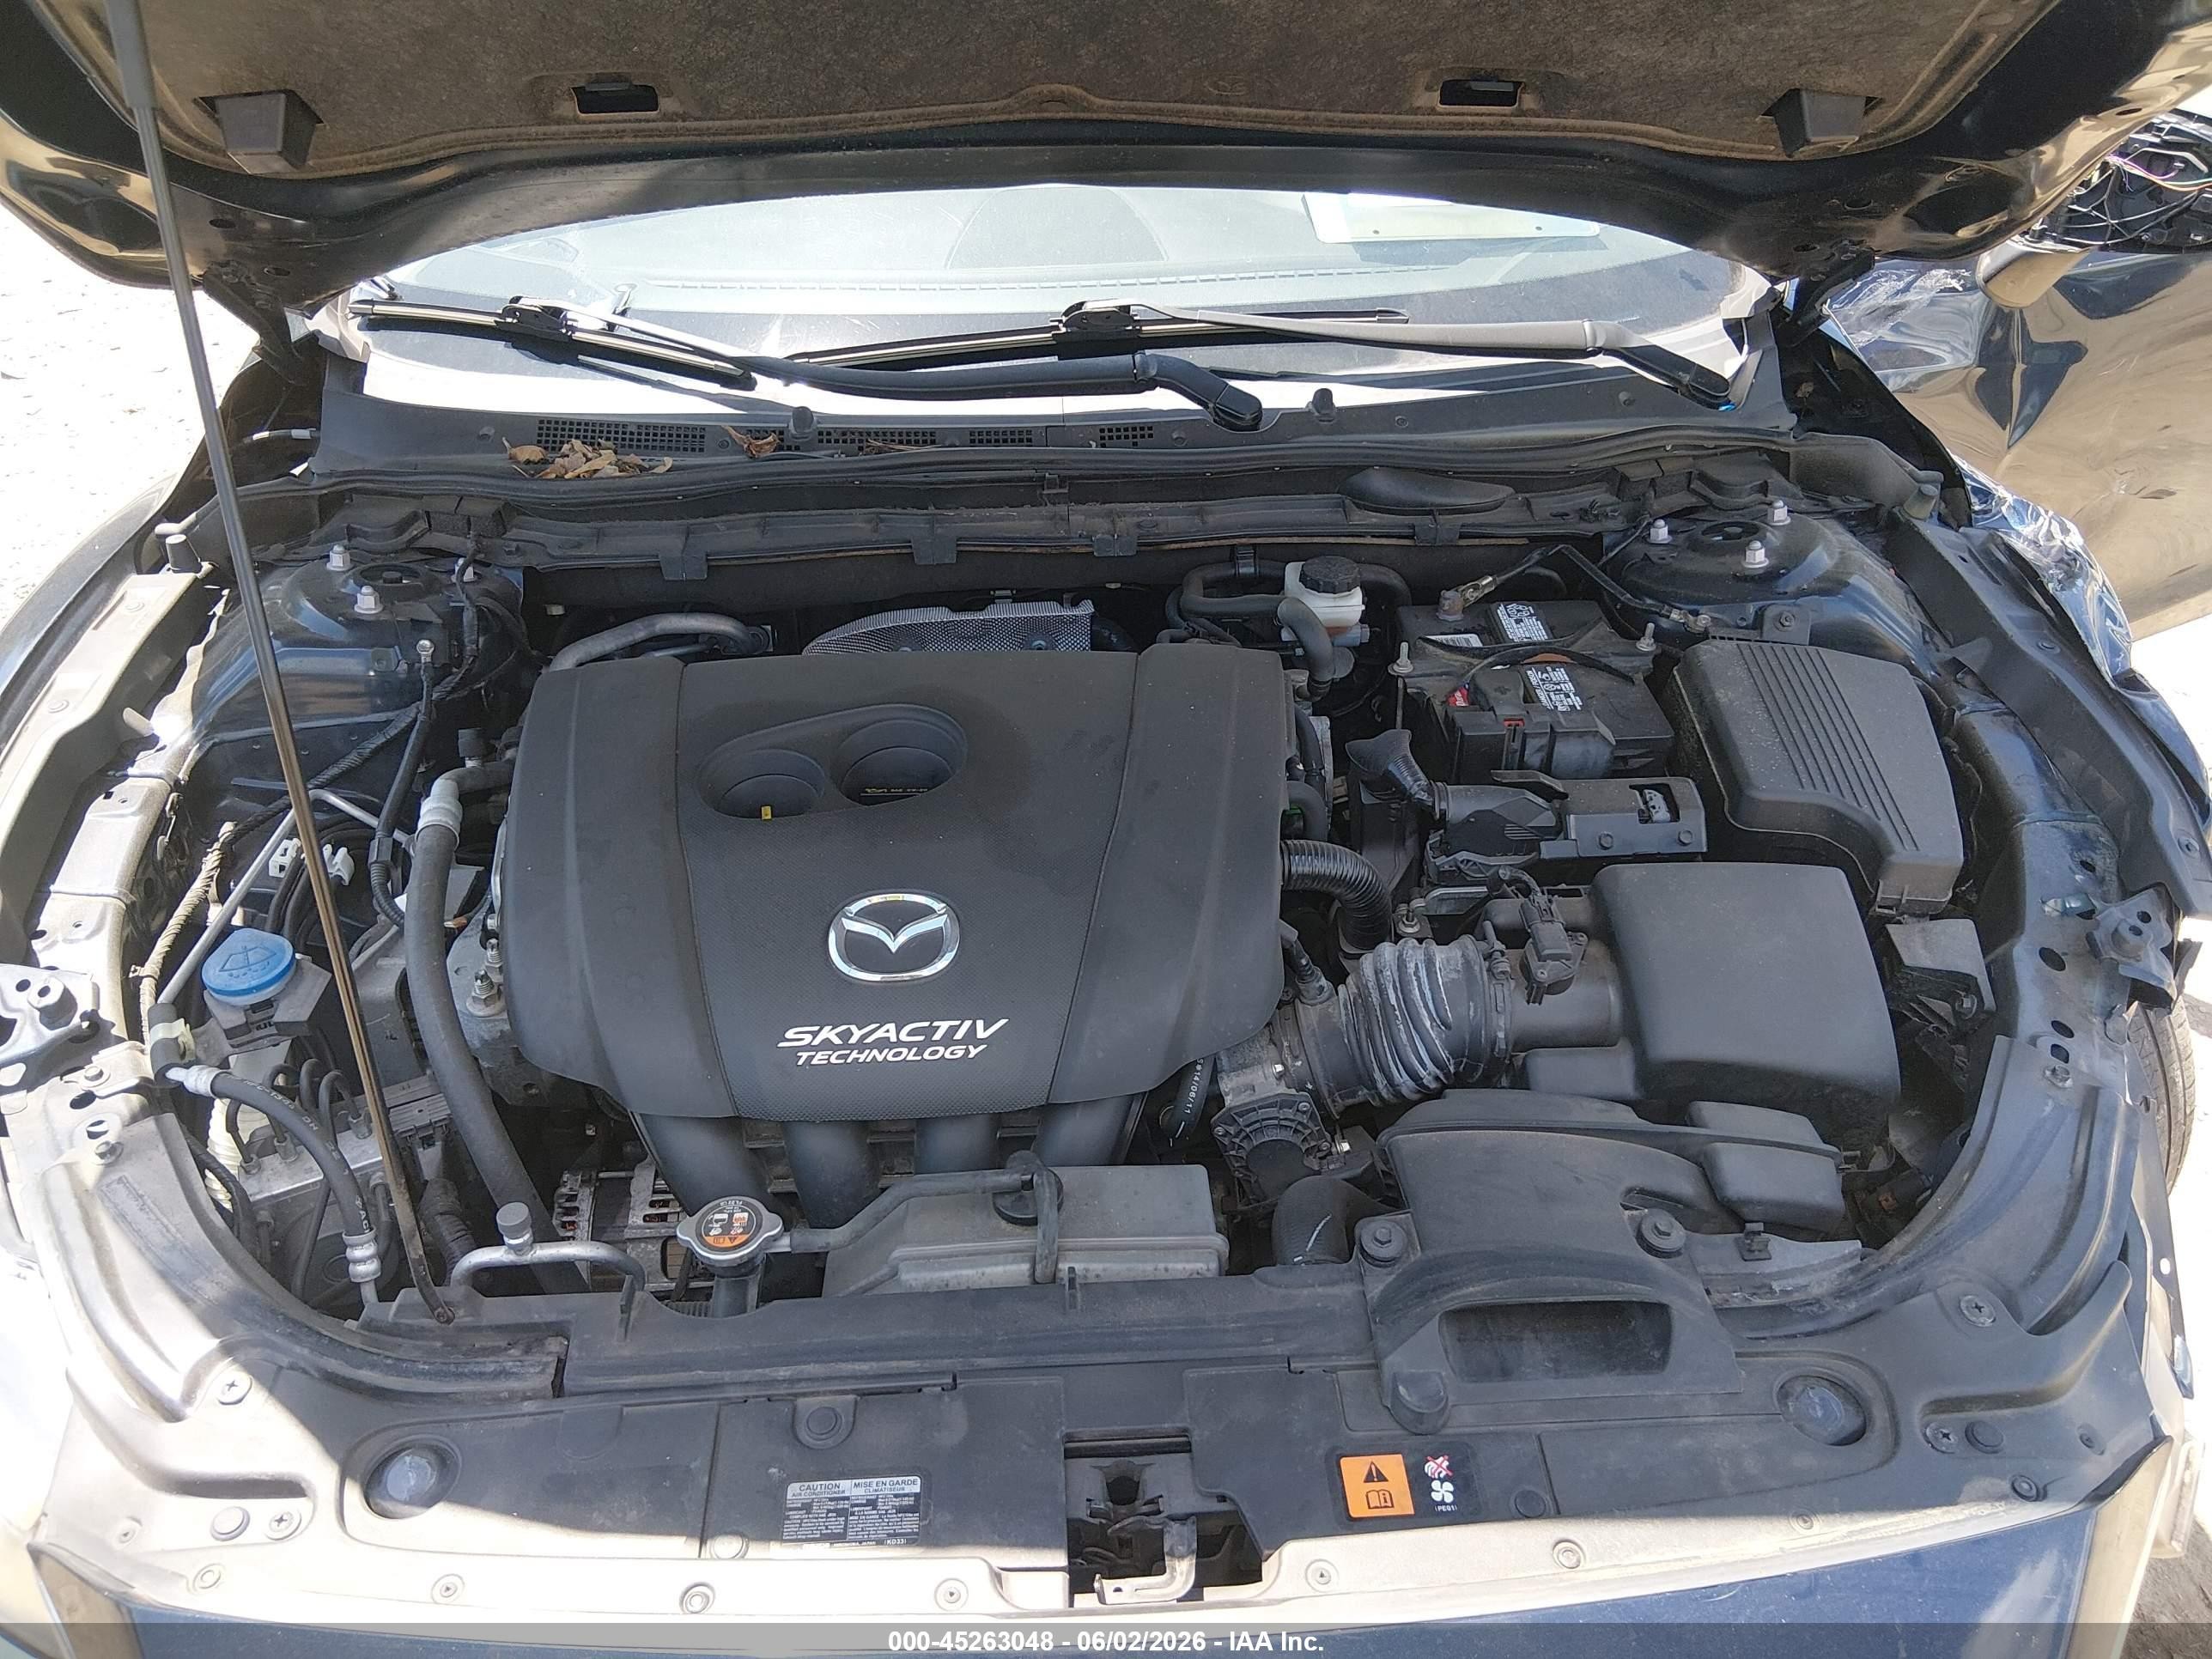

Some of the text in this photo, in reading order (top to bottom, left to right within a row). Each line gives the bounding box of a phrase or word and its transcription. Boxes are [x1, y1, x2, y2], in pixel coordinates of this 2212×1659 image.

[776, 1018, 1010, 1048] SKYACTIV
[796, 1044, 988, 1066] TECHNOLOGY
[799, 1483, 841, 1492] CAUTION
[889, 1478, 918, 1486] GARDE
